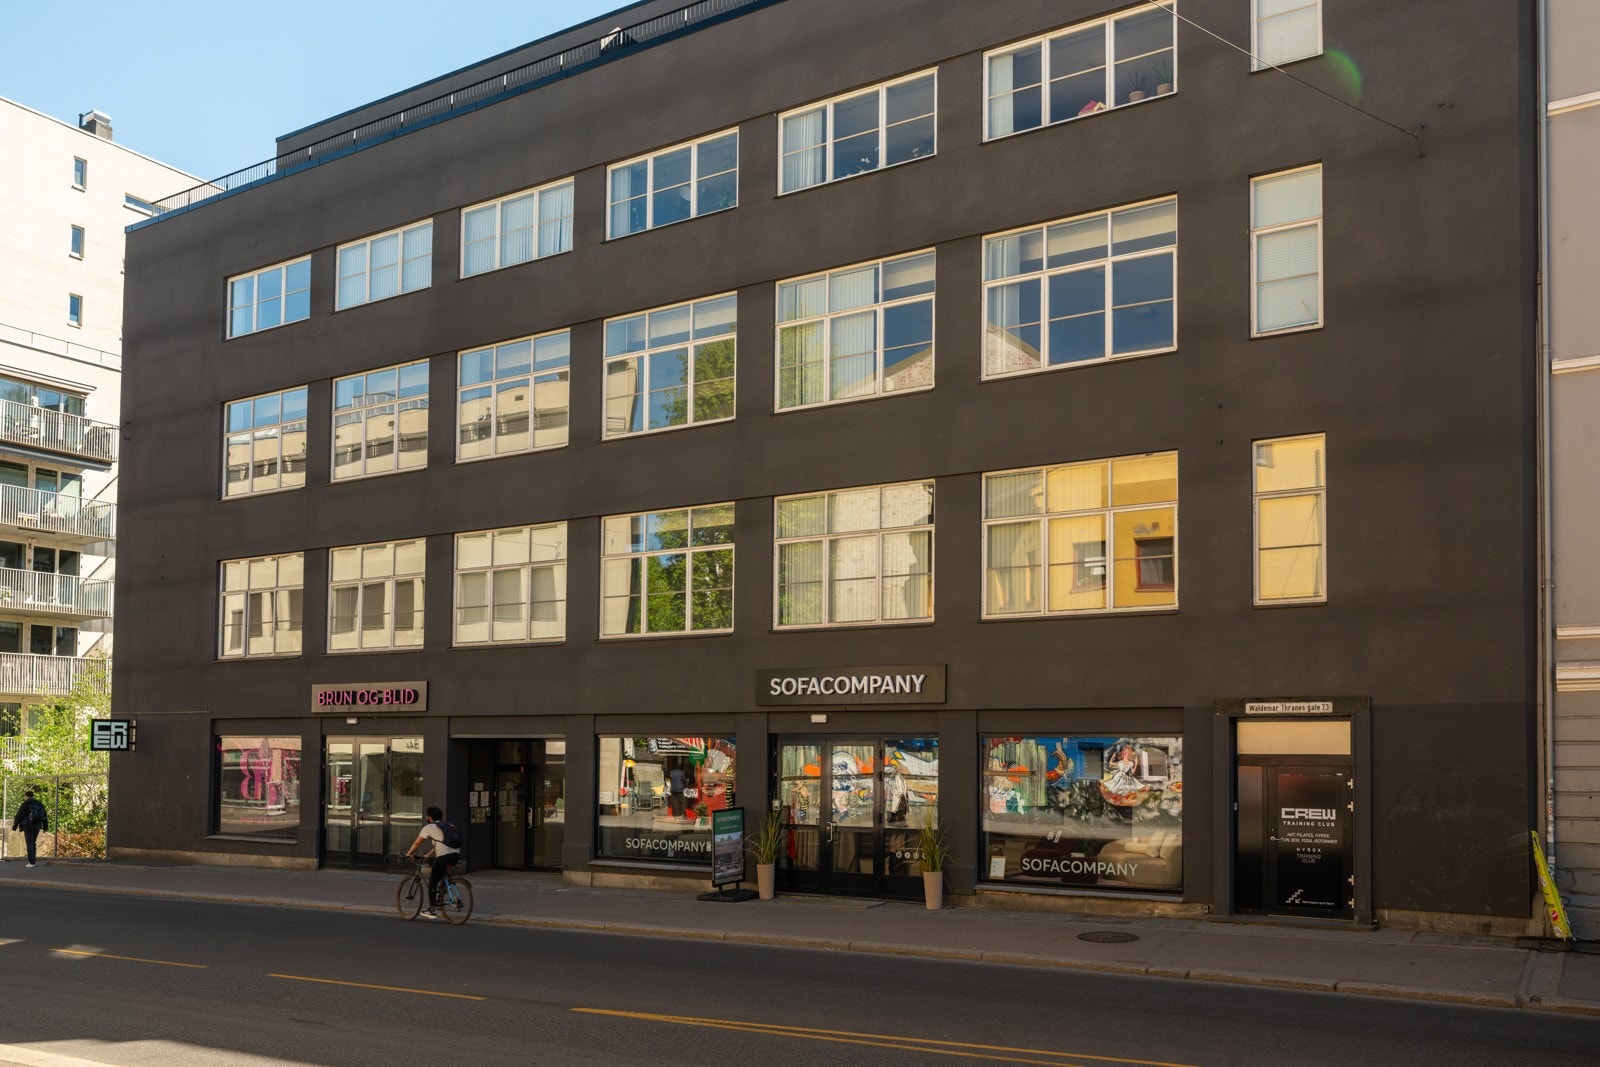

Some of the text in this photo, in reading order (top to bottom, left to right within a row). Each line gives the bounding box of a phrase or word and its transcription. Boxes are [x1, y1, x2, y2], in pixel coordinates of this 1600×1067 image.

[769, 674, 926, 695] SOFACOMPANY
[317, 688, 416, 706] BRUN OG BLID
[1248, 704, 1279, 712] Waldemar
[1307, 703, 1321, 713] gate
[1281, 808, 1336, 820] CREW
[625, 837, 706, 853] SOFACOMPANY
[1021, 857, 1138, 876] SOFACOMPANY
